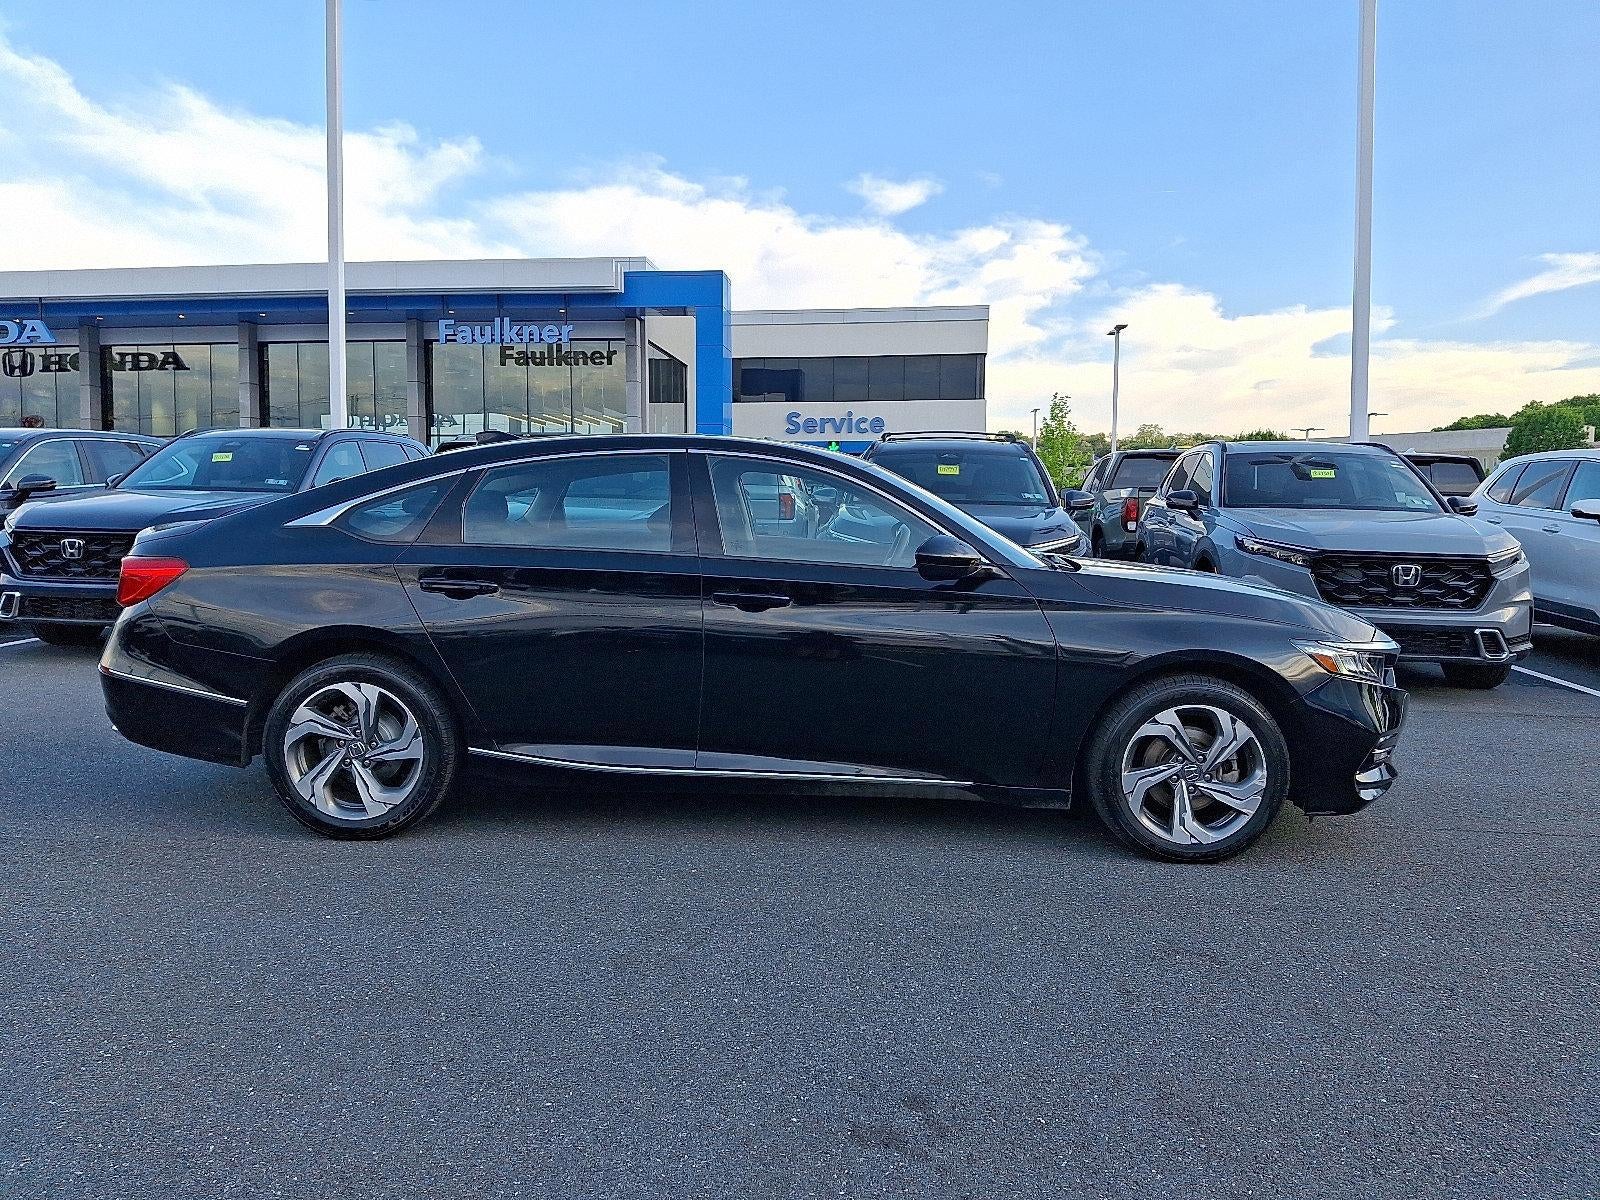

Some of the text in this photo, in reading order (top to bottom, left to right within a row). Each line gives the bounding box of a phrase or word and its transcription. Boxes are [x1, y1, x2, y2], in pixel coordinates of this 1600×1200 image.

[438, 317, 574, 344] Faulkner
[499, 343, 618, 367] Faulkner
[785, 410, 886, 434] Service
